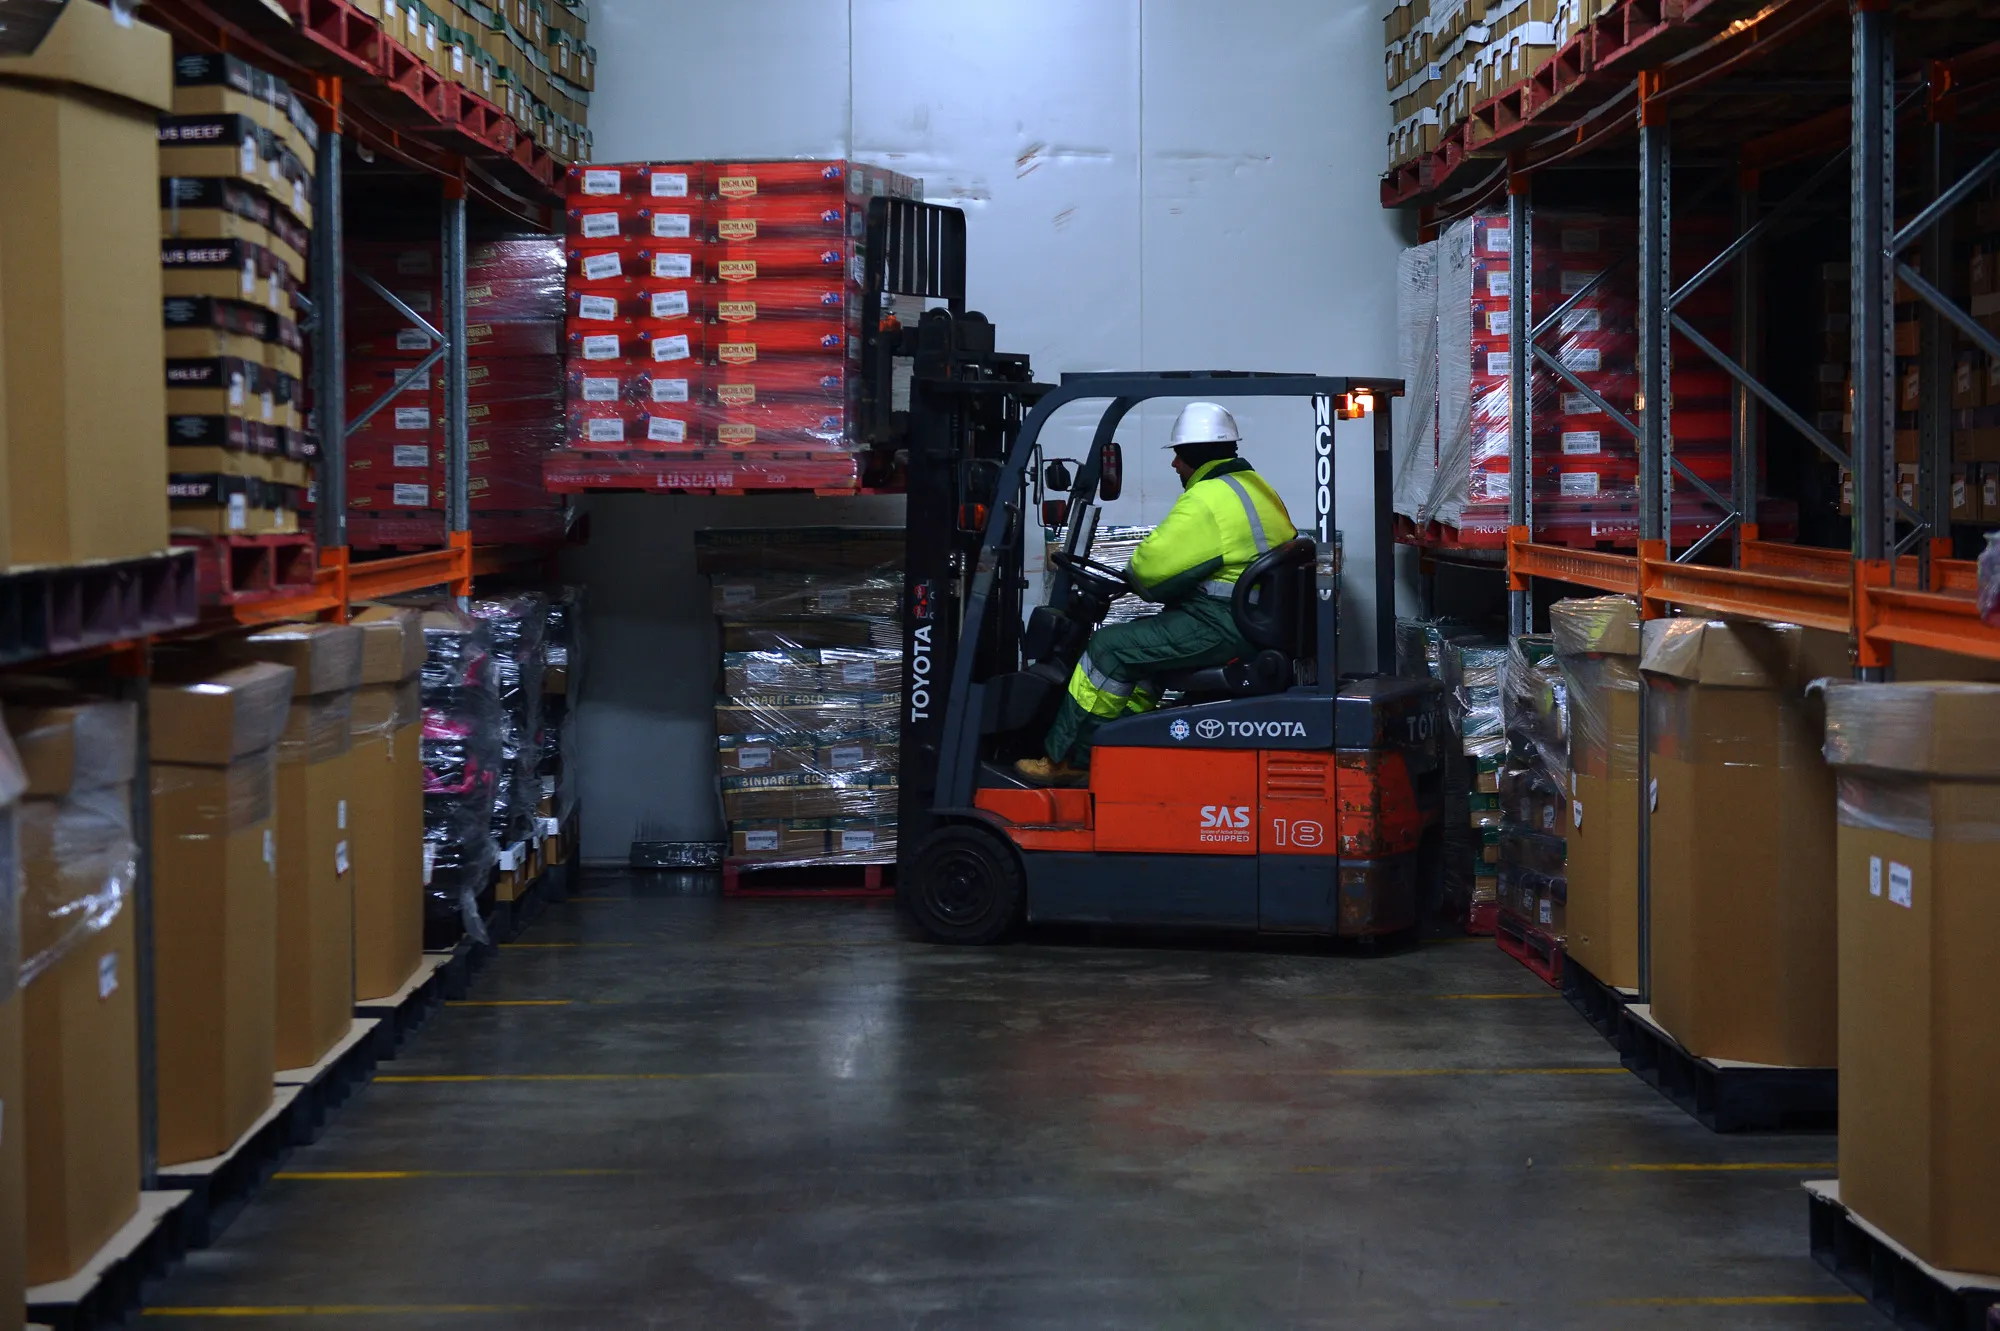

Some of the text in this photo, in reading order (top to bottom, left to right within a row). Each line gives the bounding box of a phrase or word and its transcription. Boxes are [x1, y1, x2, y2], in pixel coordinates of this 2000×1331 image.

[180, 124, 225, 139] BEEF
[720, 179, 755, 188] HIGHLAND
[720, 222, 754, 231] HIGHLAND
[186, 248, 232, 262] BEEF
[720, 263, 754, 272] HIGHLAND
[720, 304, 754, 313] HIGHLAND
[720, 345, 754, 354] HIGHLAND
[1315, 396, 1332, 543] NC001
[1473, 524, 1508, 534] PROPE
[911, 624, 932, 723] TOYOTA
[795, 694, 825, 704] GOLD
[1227, 721, 1307, 738] TOYOTA
[1200, 805, 1250, 828] SAS
[1273, 818, 1324, 848] 18
